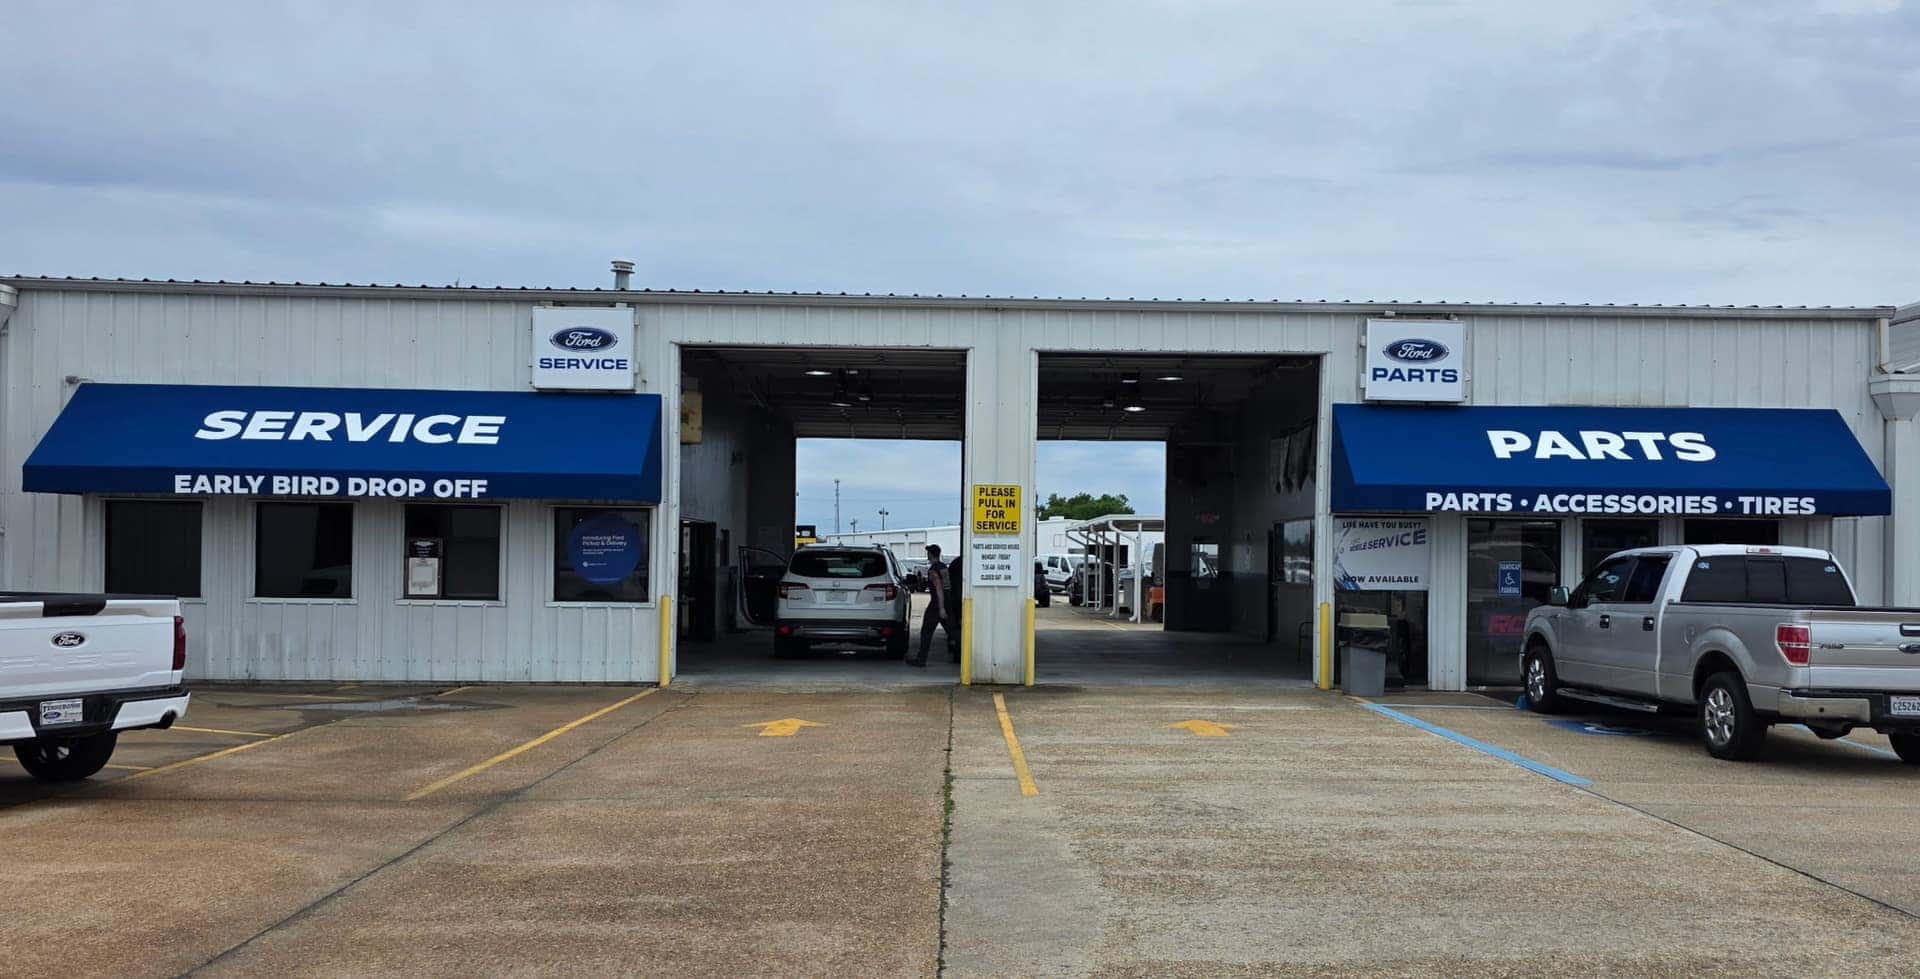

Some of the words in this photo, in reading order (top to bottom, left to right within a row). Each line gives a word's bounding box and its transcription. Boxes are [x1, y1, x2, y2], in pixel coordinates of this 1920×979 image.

[539, 358, 629, 370] SERVICE
[1372, 367, 1459, 383] PARTS
[194, 410, 506, 445] SERVICE
[1486, 430, 1717, 462] PARTS
[174, 474, 265, 495] EARLY
[272, 475, 340, 496] BIRD
[347, 477, 426, 497] DROP
[433, 479, 488, 498] OFF
[979, 487, 1015, 497] PLEASE
[978, 499, 1002, 508] PULL
[1005, 499, 1015, 508] IN
[1425, 492, 1513, 512] PARTS
[1533, 494, 1718, 514] ACCESSORIES
[1738, 495, 1817, 515] TIRES
[986, 510, 1005, 519] FOR
[976, 520, 1017, 530] SERVICE
[1359, 521, 1378, 529] HAVE
[1381, 521, 1397, 529] YOU
[1367, 528, 1426, 550] SERVICE
